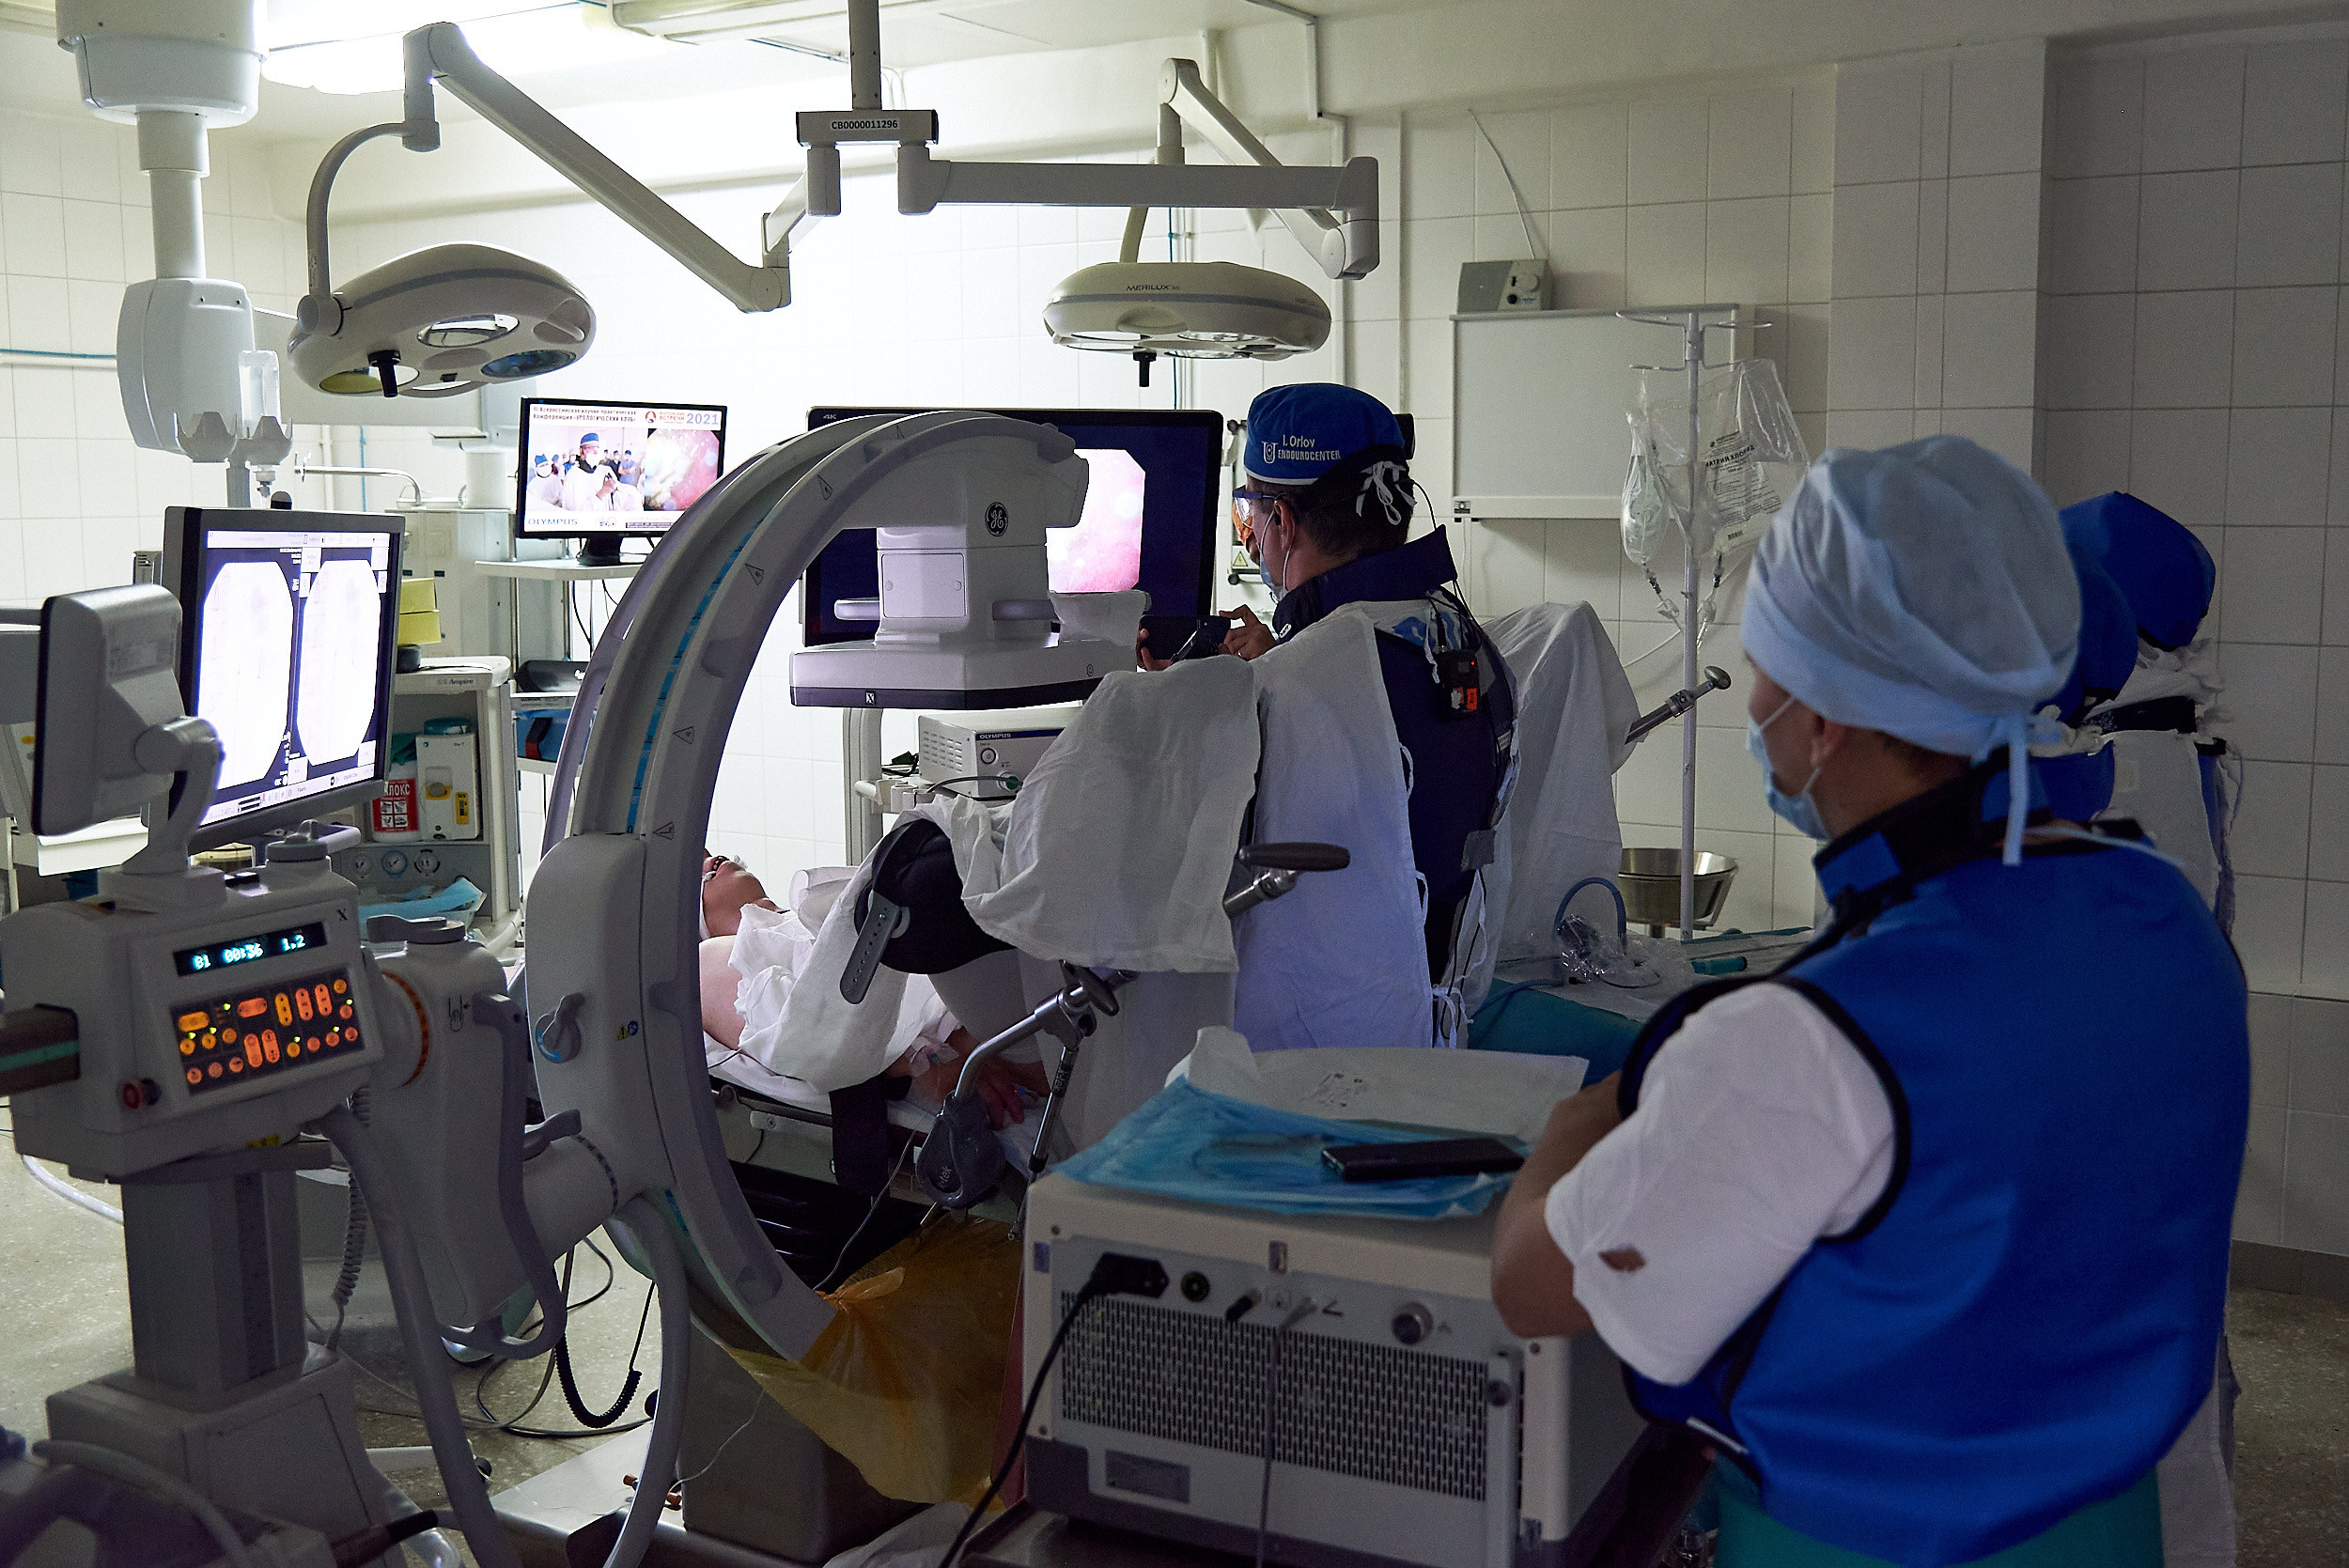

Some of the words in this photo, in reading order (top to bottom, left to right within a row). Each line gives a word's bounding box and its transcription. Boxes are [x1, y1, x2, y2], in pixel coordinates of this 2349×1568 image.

[832, 119, 898, 130] CB0000011296
[686, 412, 719, 425] 2021
[1283, 434, 1288, 446] I.
[1289, 435, 1315, 448] Orlov
[1278, 449, 1341, 461] ENDOUROCENTER
[527, 518, 579, 526] OLYMPUS
[223, 942, 264, 964] 00:36
[281, 934, 306, 952] 1.2
